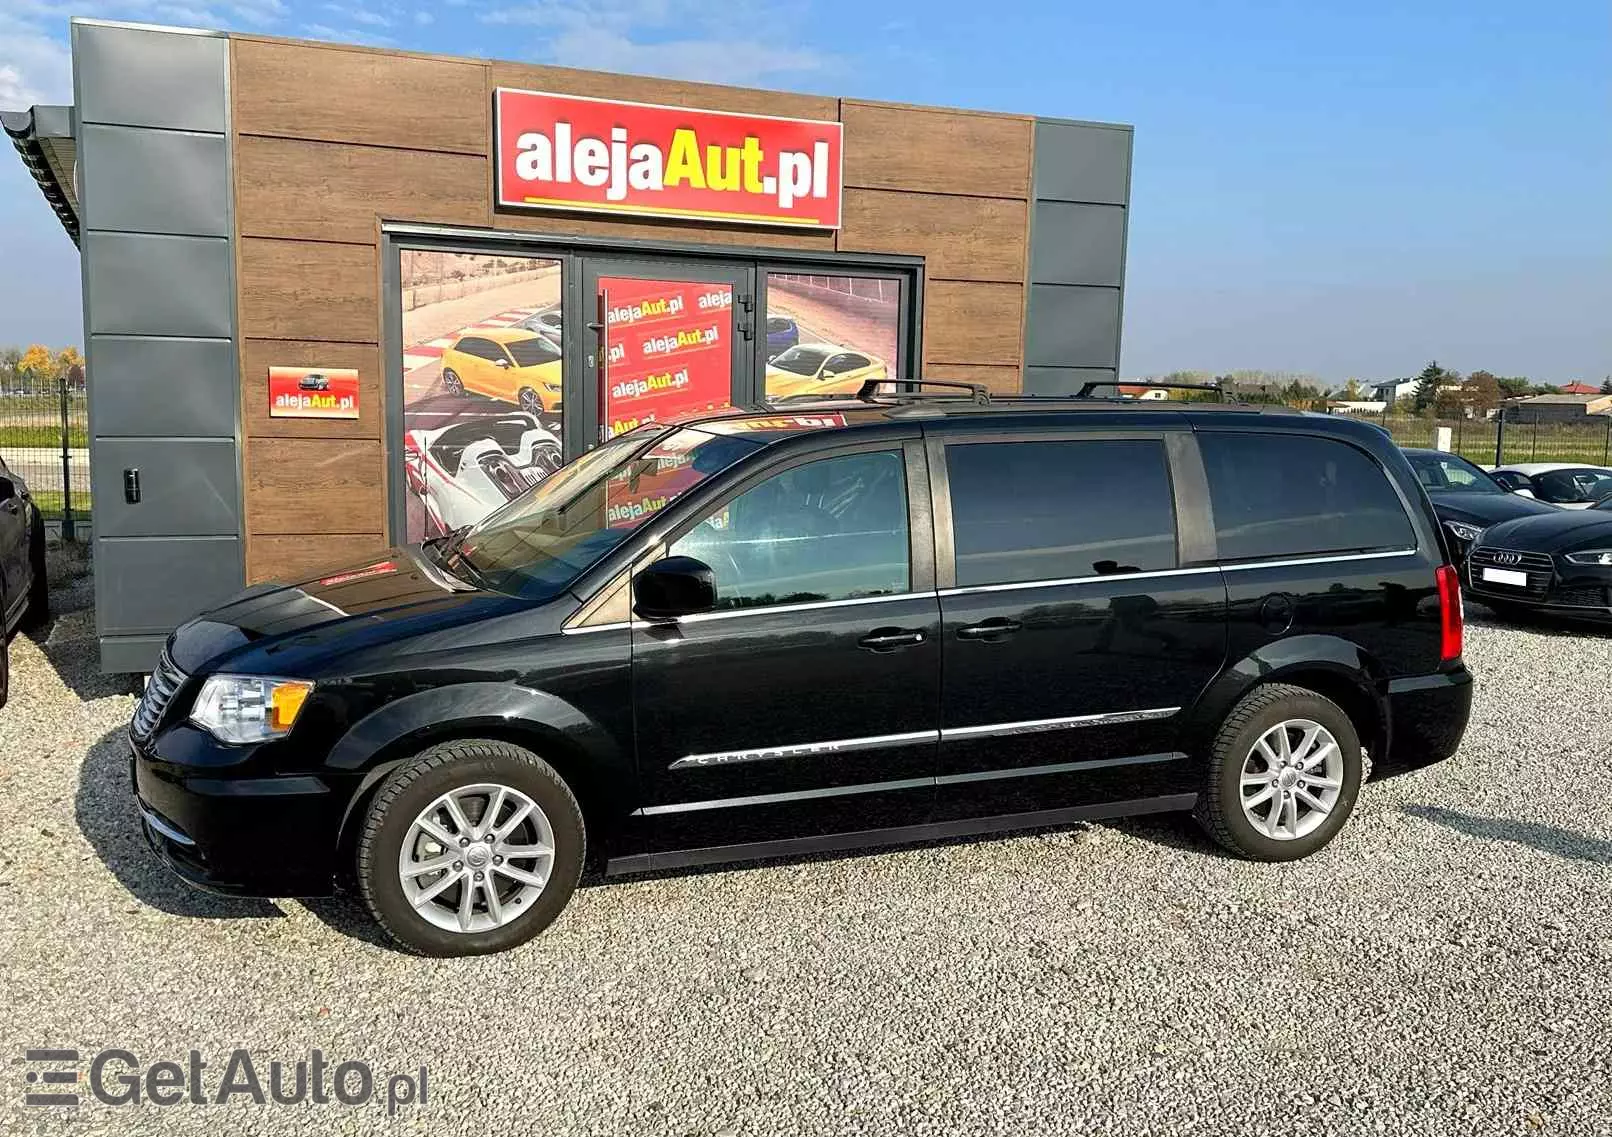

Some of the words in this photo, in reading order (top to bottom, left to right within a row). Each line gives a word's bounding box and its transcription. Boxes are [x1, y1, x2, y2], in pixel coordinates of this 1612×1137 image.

[515, 120, 829, 209] alejaAut.pl
[607, 295, 684, 324] alejaAut.pl
[642, 326, 720, 355] alejaAut.pl
[611, 369, 689, 399] alejaAut.pl
[275, 393, 354, 410] alejaAut.pl
